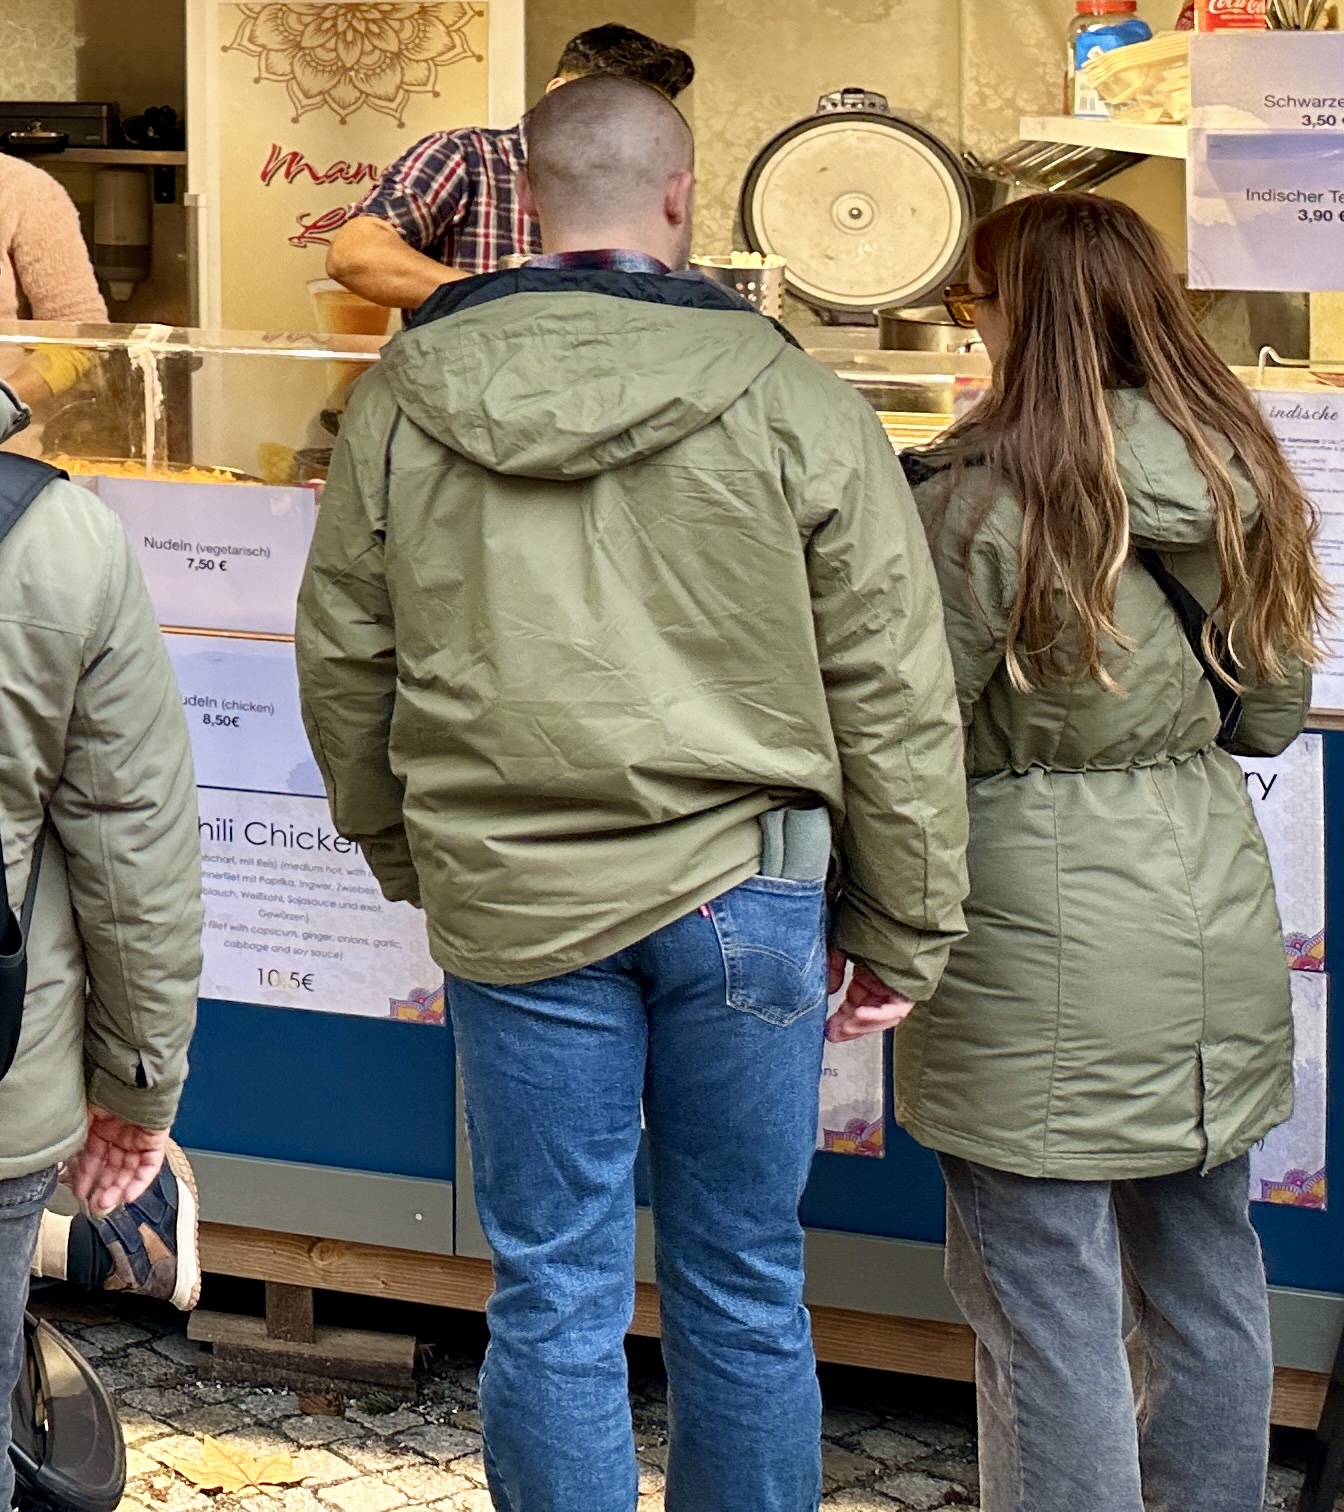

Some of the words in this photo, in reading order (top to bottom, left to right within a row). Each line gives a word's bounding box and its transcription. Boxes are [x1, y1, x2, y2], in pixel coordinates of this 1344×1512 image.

[1302, 115, 1336, 128] 3,50
[261, 143, 388, 186] Man
[1246, 188, 1324, 203] Indischer
[1298, 209, 1333, 222] 3,90
[143, 536, 193, 553] Nudeln
[195, 541, 271, 560] (vegetarisch)
[186, 558, 215, 573] 7,50
[218, 559, 228, 572] €
[221, 698, 275, 716] (chicken)
[202, 714, 240, 729] 8,50€
[198, 816, 233, 842] hili
[224, 940, 269, 952] cabbage
[271, 944, 291, 954] and
